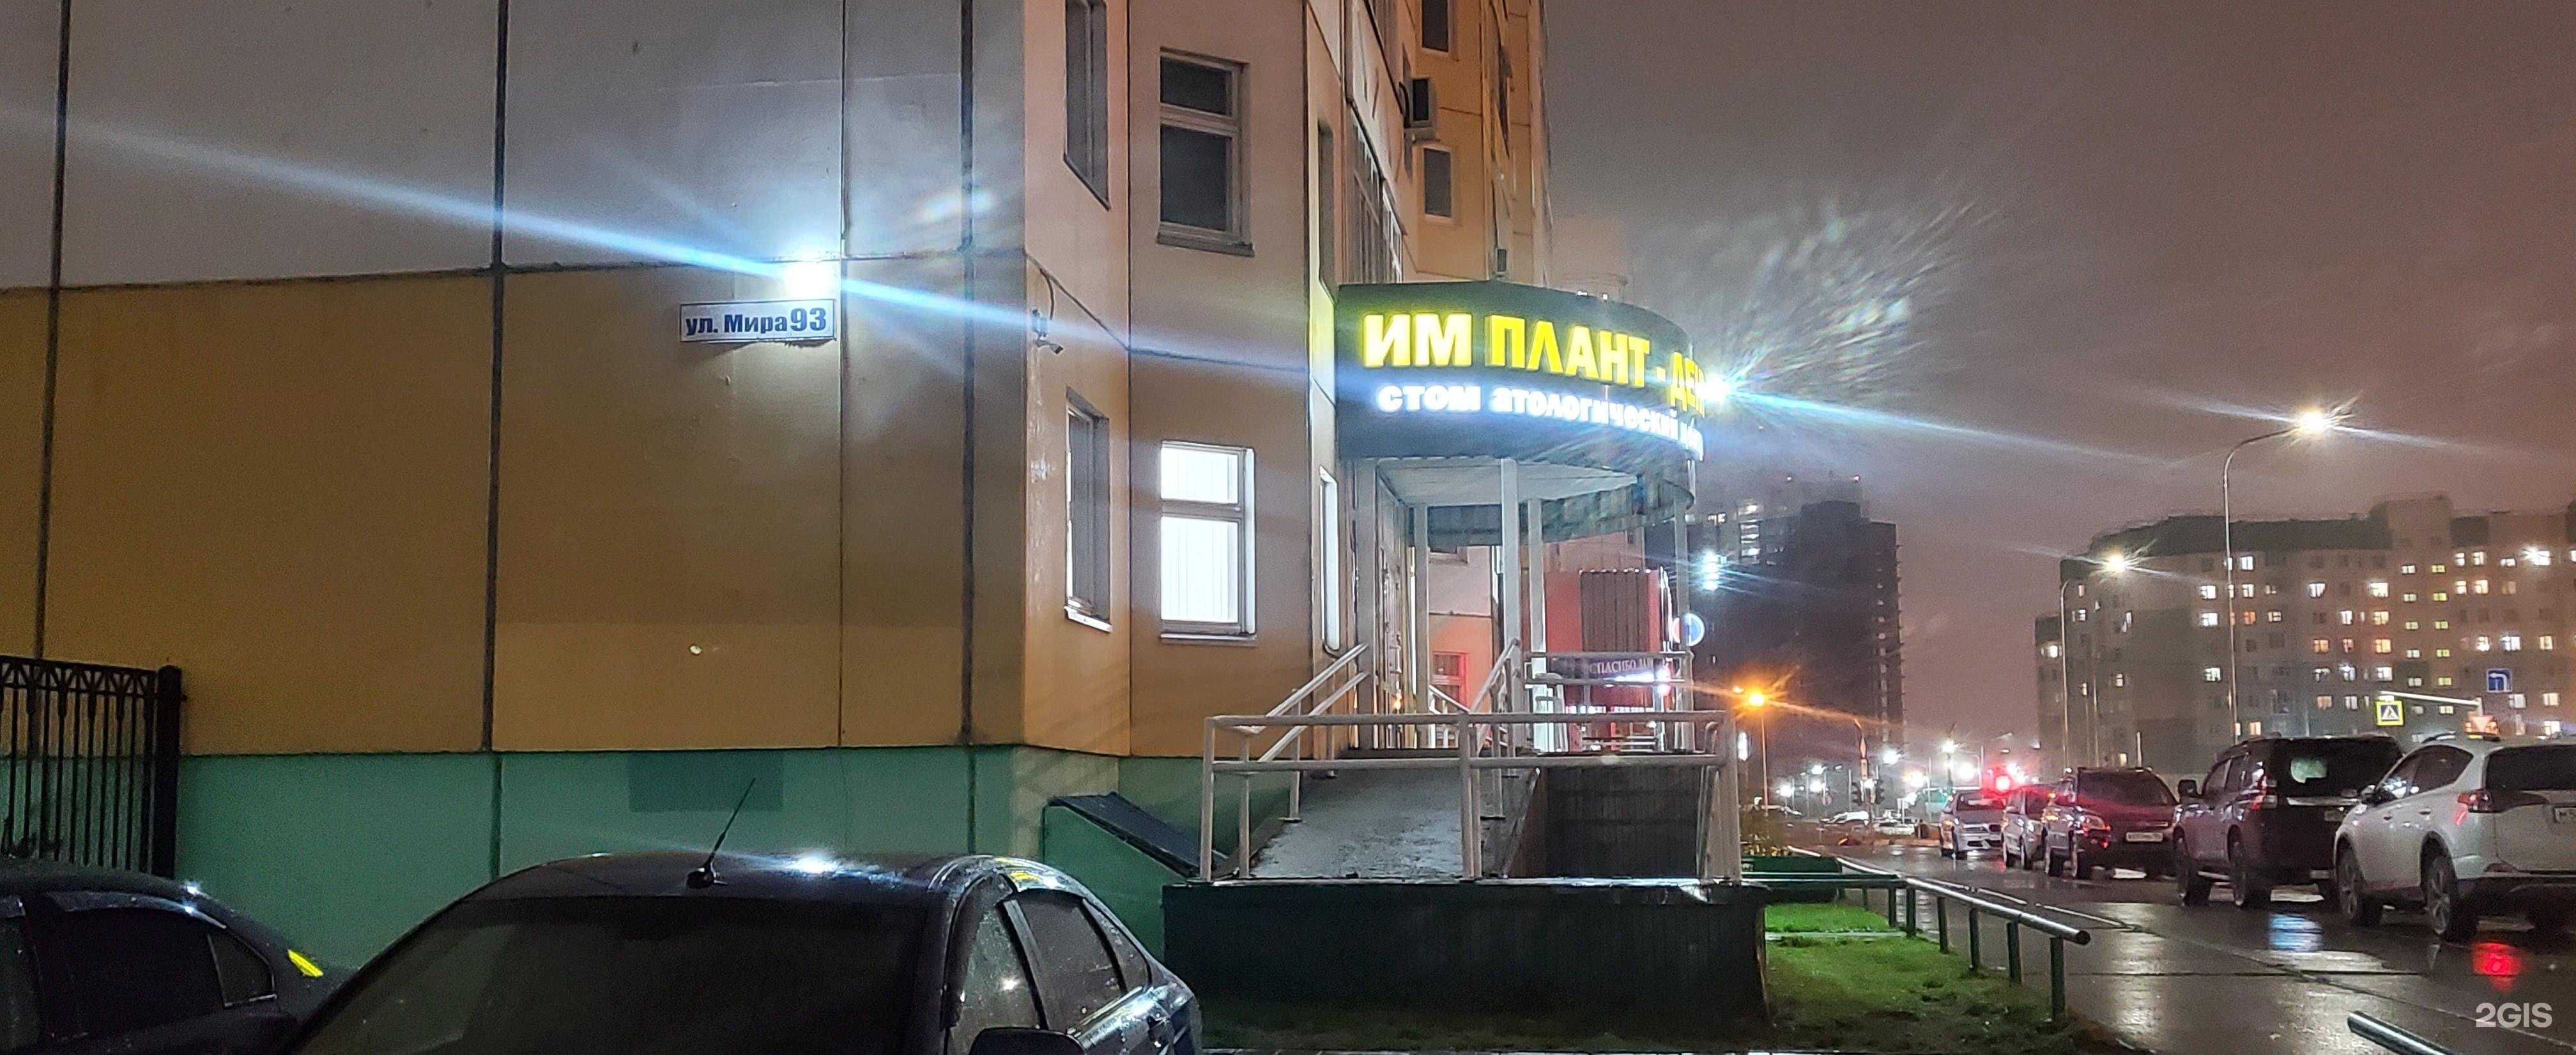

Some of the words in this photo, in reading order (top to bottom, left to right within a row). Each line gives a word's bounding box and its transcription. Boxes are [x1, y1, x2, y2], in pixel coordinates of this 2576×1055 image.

[686, 318, 719, 336] ул.
[724, 314, 787, 334] Мира
[790, 307, 827, 331] 93
[1363, 314, 1472, 367] ИМ
[1485, 314, 1650, 388] ПЛАНТ
[1377, 385, 1481, 412] стом
